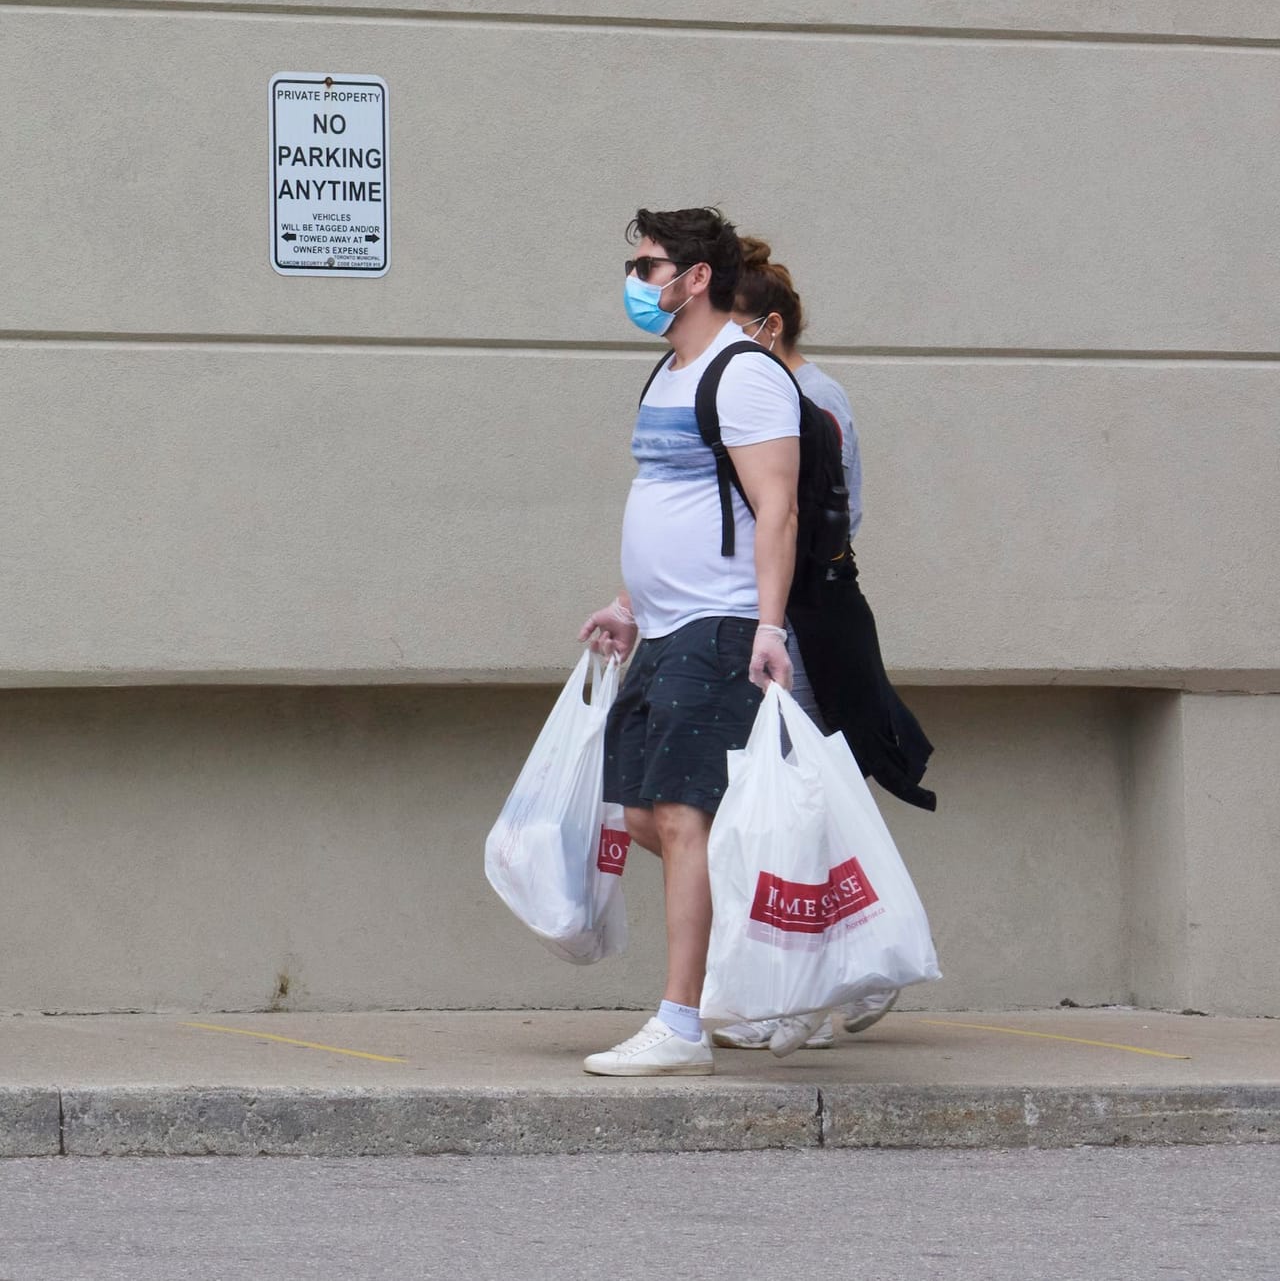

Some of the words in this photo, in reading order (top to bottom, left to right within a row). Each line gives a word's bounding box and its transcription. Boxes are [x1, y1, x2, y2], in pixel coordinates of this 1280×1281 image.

[277, 90, 320, 101] PRIVATE
[323, 91, 381, 103] PROPERTY
[313, 113, 346, 135] NO
[278, 145, 382, 169] PARKING
[278, 179, 382, 202] ANYTIME
[312, 213, 351, 222] VEHICLES
[281, 223, 299, 231] WILL
[302, 223, 313, 232] BE
[315, 224, 348, 232] TAGGED
[349, 225, 380, 233] AND/OR
[299, 234, 328, 243] TOWED
[329, 235, 351, 243] AWAY
[353, 236, 363, 244] AT
[293, 245, 330, 254] OWNER'S
[332, 246, 369, 255] EXPENSE
